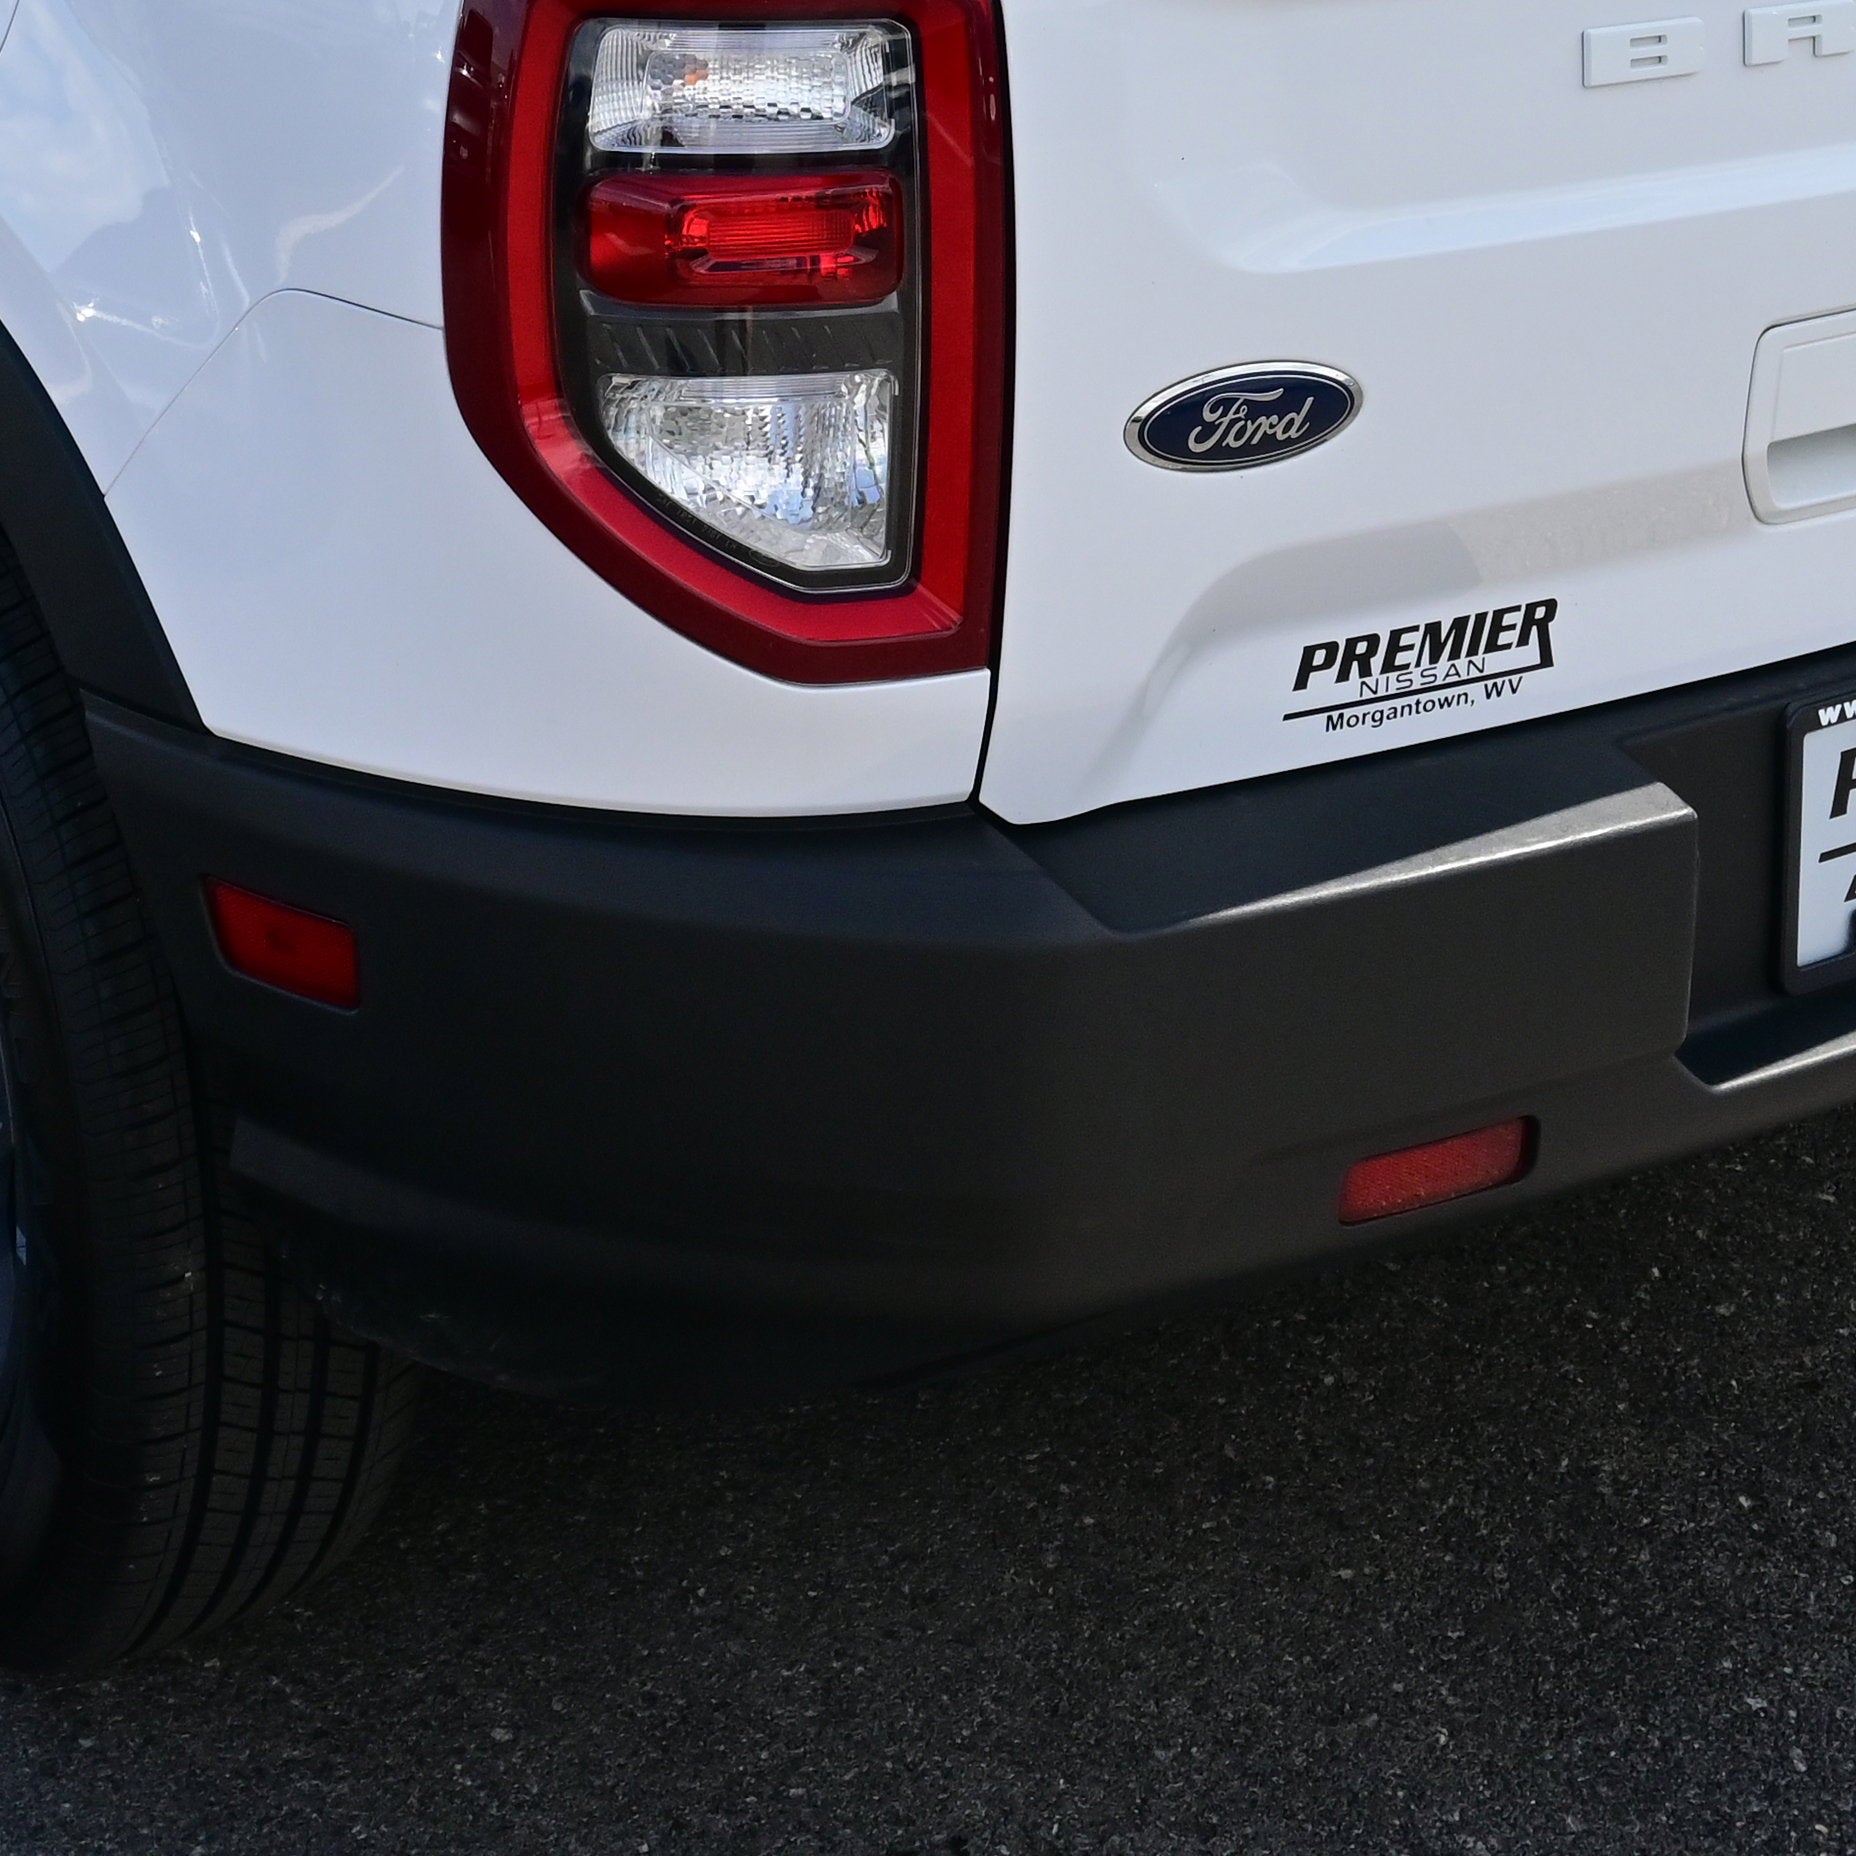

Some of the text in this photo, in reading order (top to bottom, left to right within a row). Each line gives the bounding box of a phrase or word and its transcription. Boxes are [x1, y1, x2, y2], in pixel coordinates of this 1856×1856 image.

[1187, 387, 1316, 454] Ford
[1291, 597, 1559, 692] PREMIER
[1324, 676, 1524, 733] Morgantown, WV
[1358, 656, 1486, 699] NISSAN
